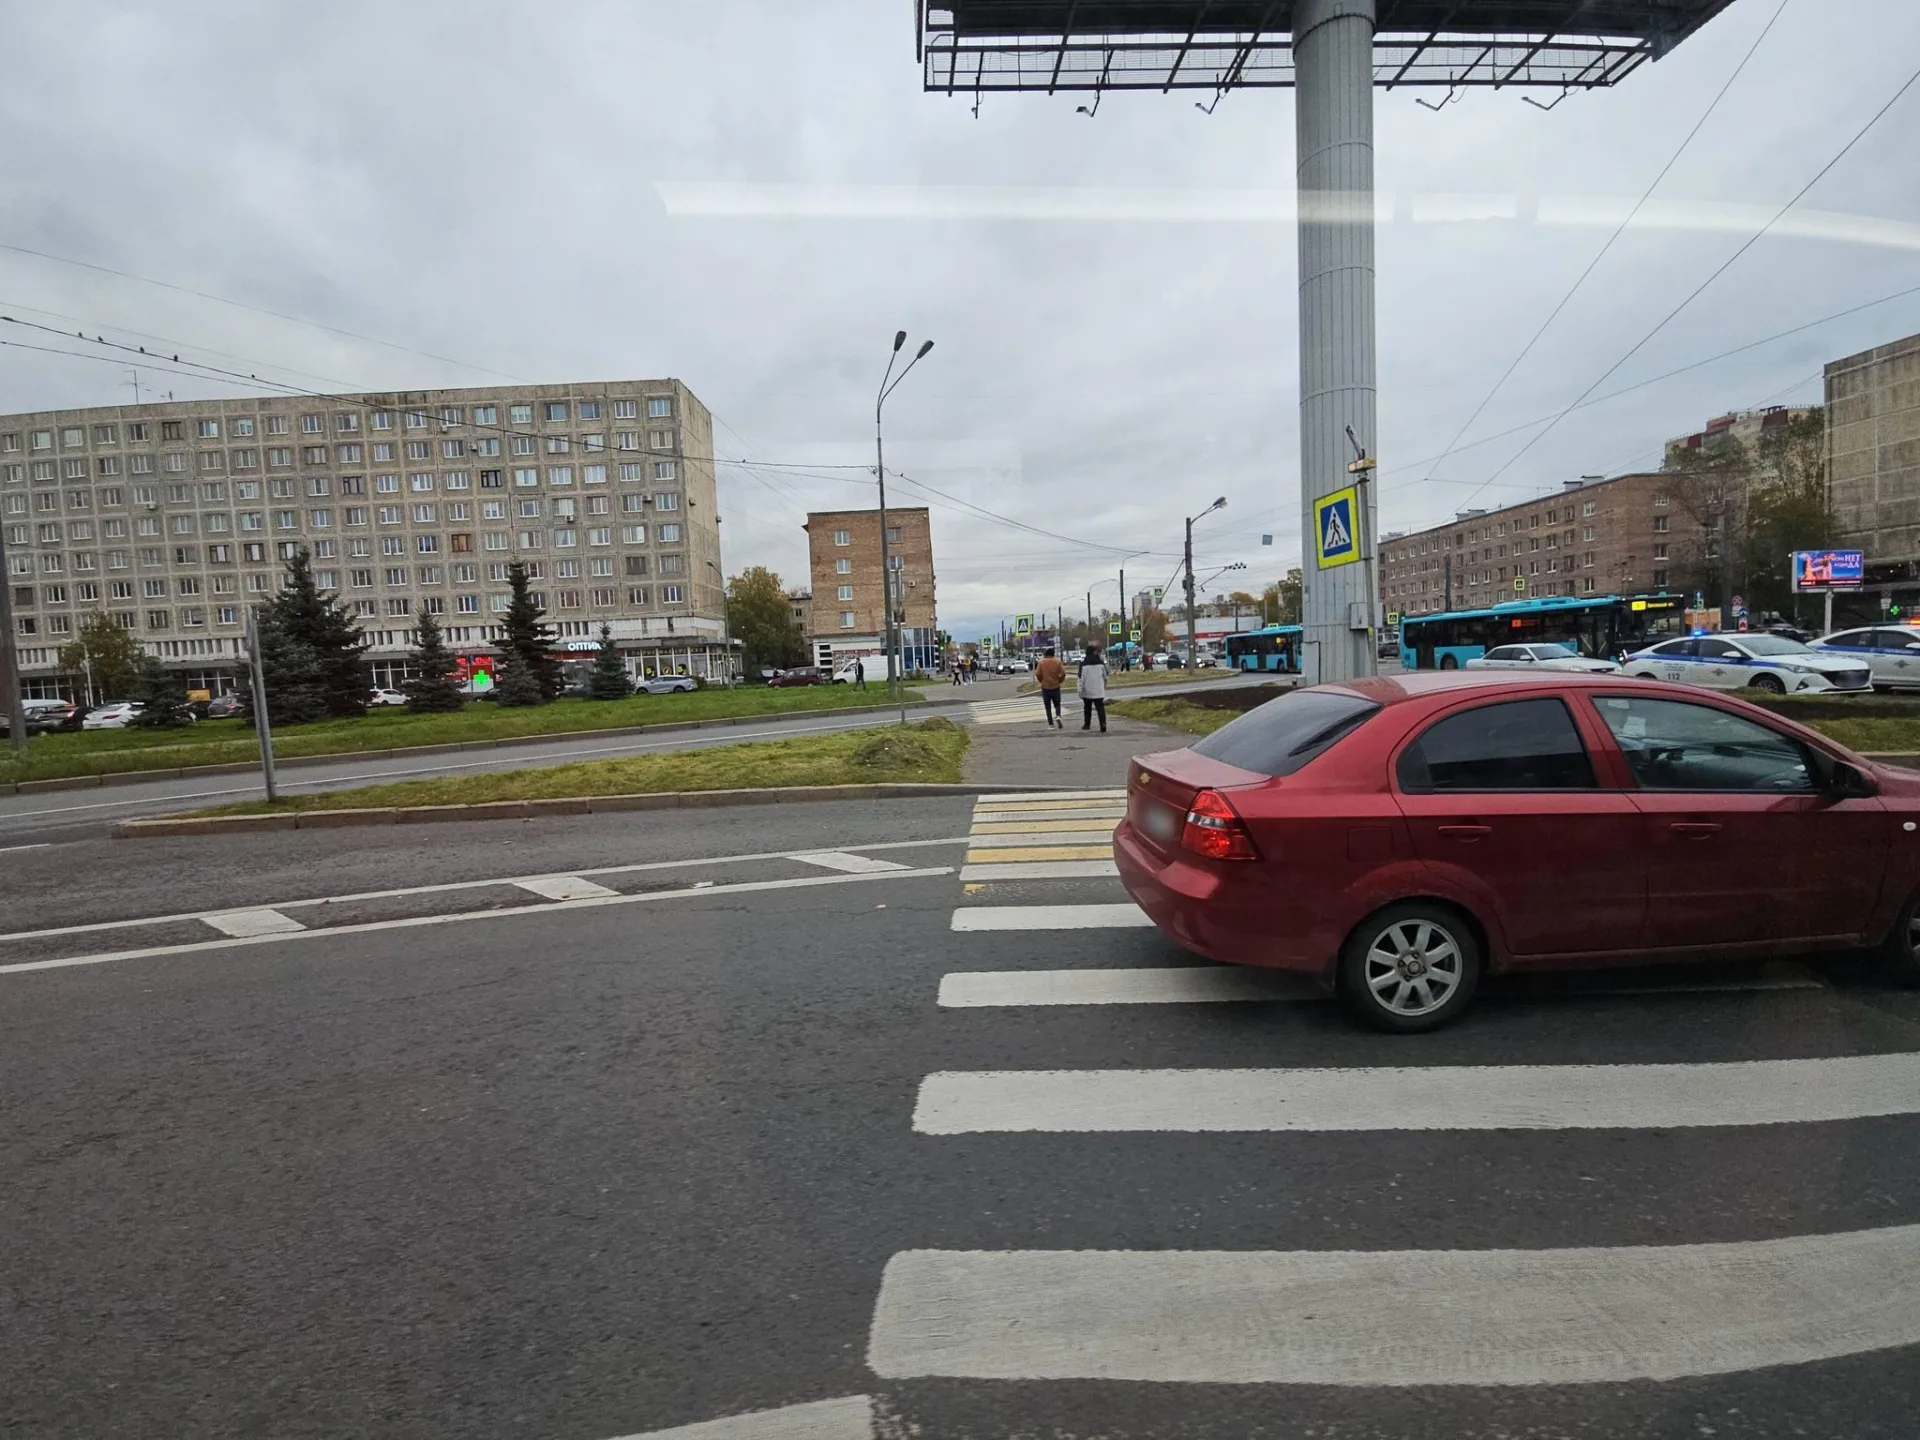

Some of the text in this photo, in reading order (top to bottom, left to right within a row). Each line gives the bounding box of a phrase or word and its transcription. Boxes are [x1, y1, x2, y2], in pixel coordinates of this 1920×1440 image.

[1845, 554, 1860, 562] НЕТ
[567, 641, 605, 652] ОПТИК
[1667, 672, 1681, 681] 112
